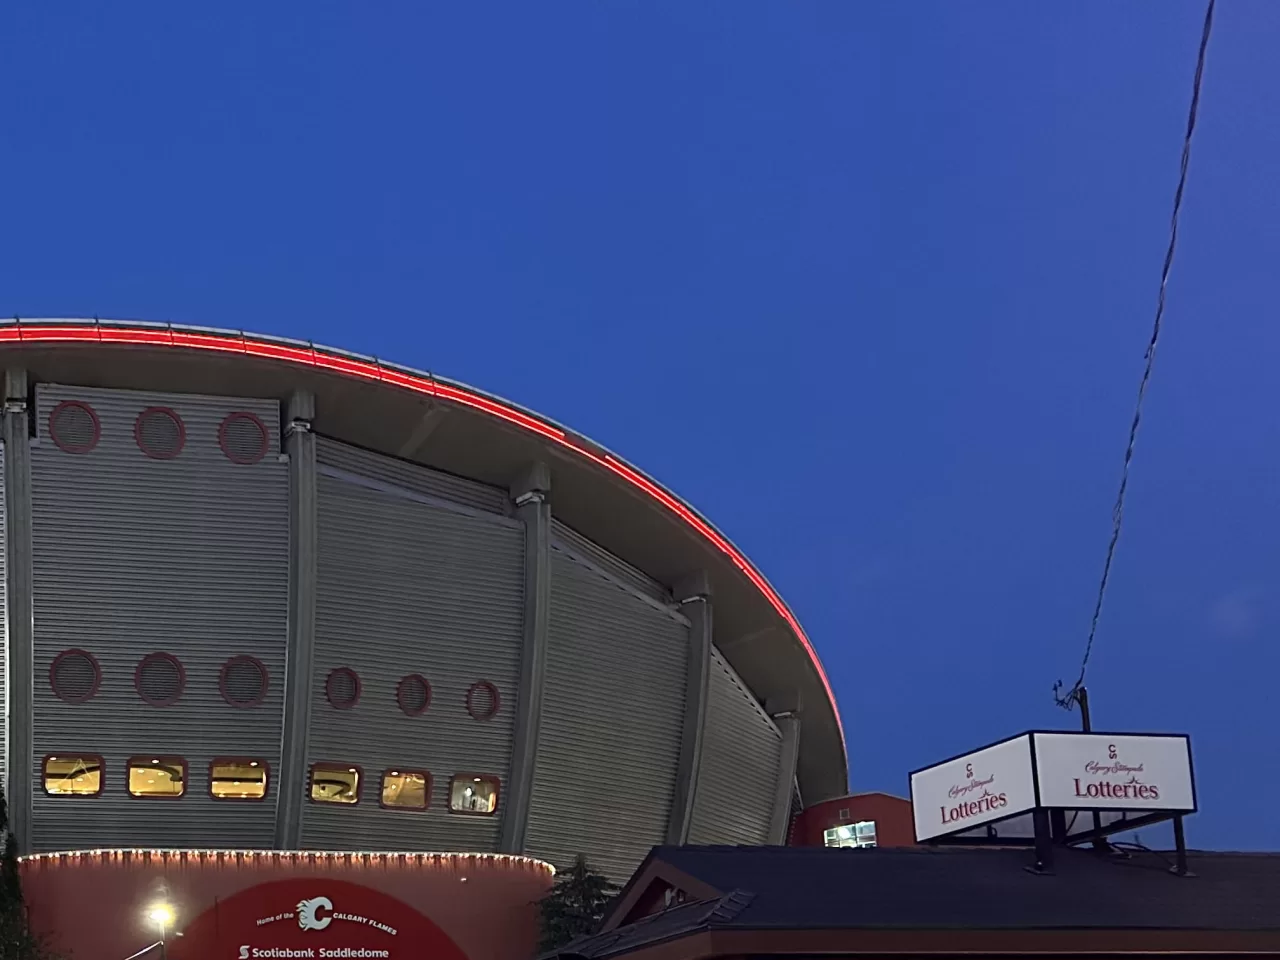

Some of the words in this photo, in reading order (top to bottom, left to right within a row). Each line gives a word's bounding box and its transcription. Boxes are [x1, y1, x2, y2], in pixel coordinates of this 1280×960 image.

[1073, 778, 1159, 799] Lotteries
[940, 791, 1007, 824] Lotteries
[256, 917, 274, 926] Home
[276, 913, 283, 921] of
[333, 912, 368, 924] CALGARY
[368, 919, 398, 936] FLAMES
[252, 948, 314, 958] Scotiabank
[319, 948, 389, 958] Saddledome
